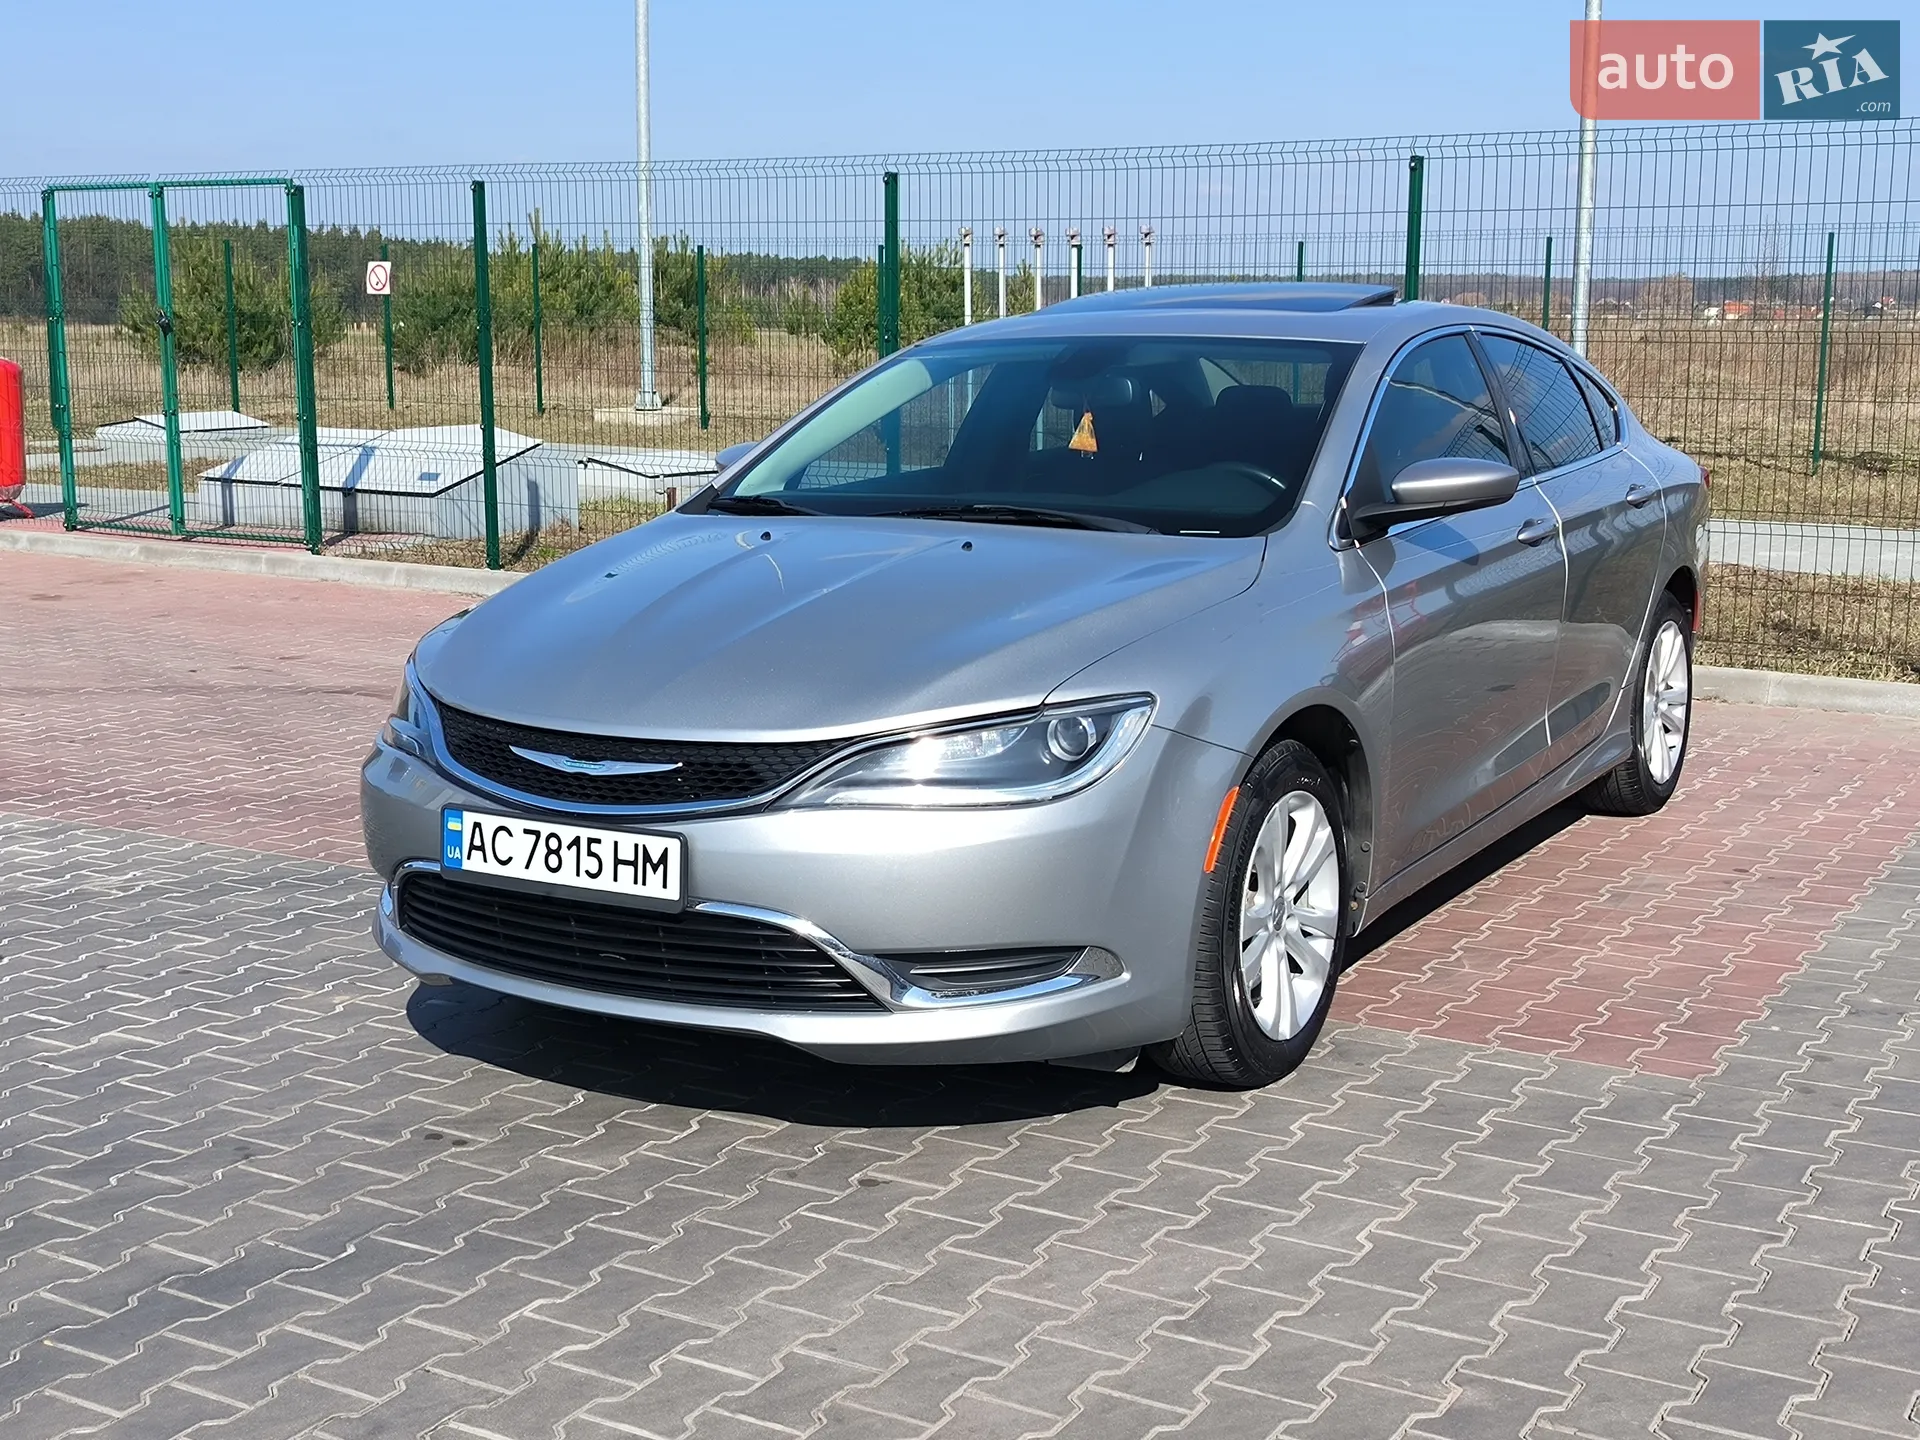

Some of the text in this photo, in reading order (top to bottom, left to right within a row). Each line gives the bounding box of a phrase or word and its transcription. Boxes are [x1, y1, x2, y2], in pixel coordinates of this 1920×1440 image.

[447, 845, 461, 860] UA
[466, 821, 669, 889] AC 7815 HM
